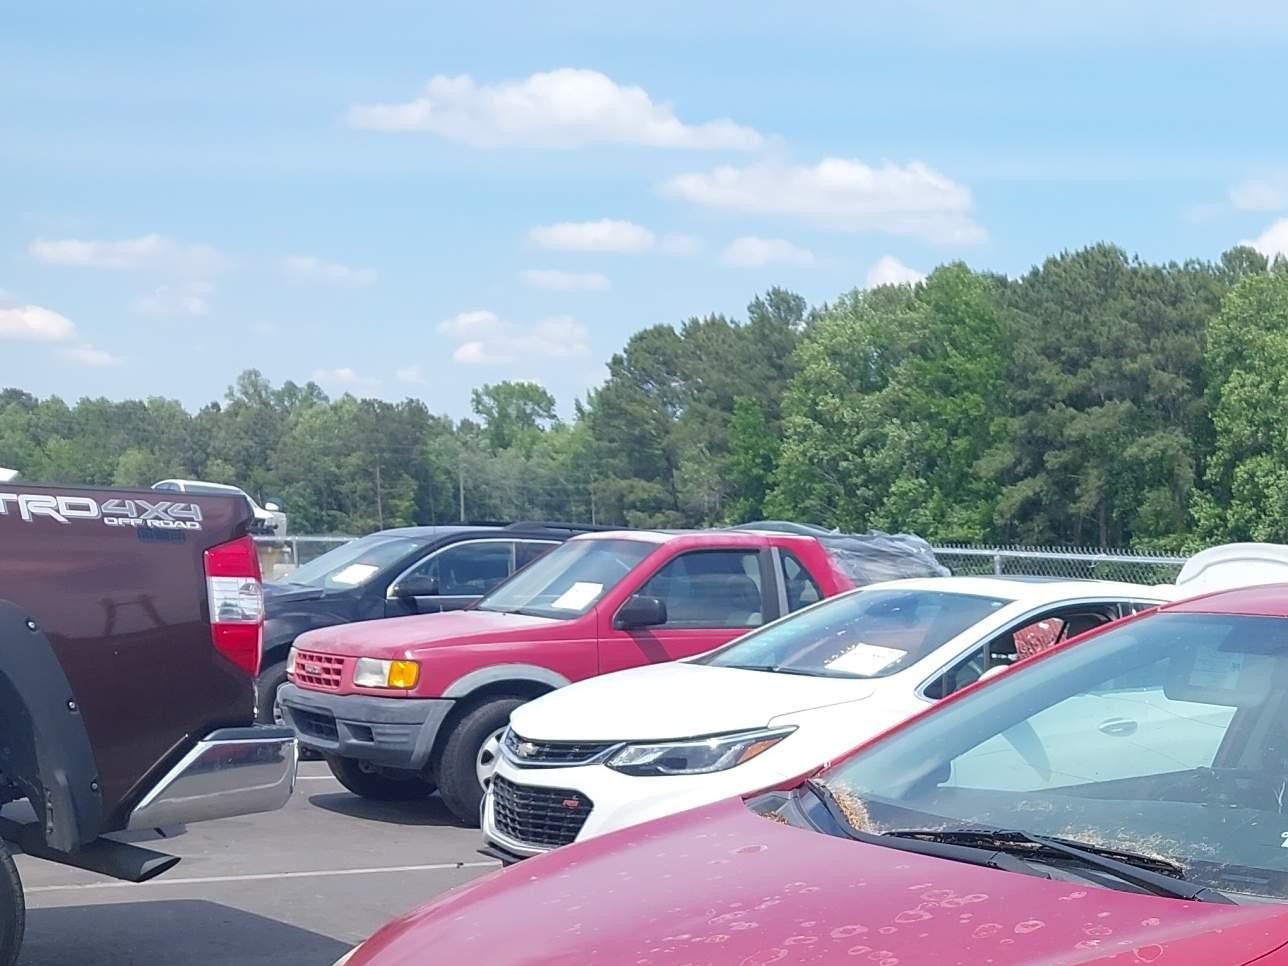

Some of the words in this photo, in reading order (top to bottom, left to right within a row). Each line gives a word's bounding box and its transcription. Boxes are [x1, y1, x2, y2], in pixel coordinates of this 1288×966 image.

[0, 493, 102, 525] TRD
[103, 516, 144, 527] OFF
[147, 518, 202, 530] ROAD
